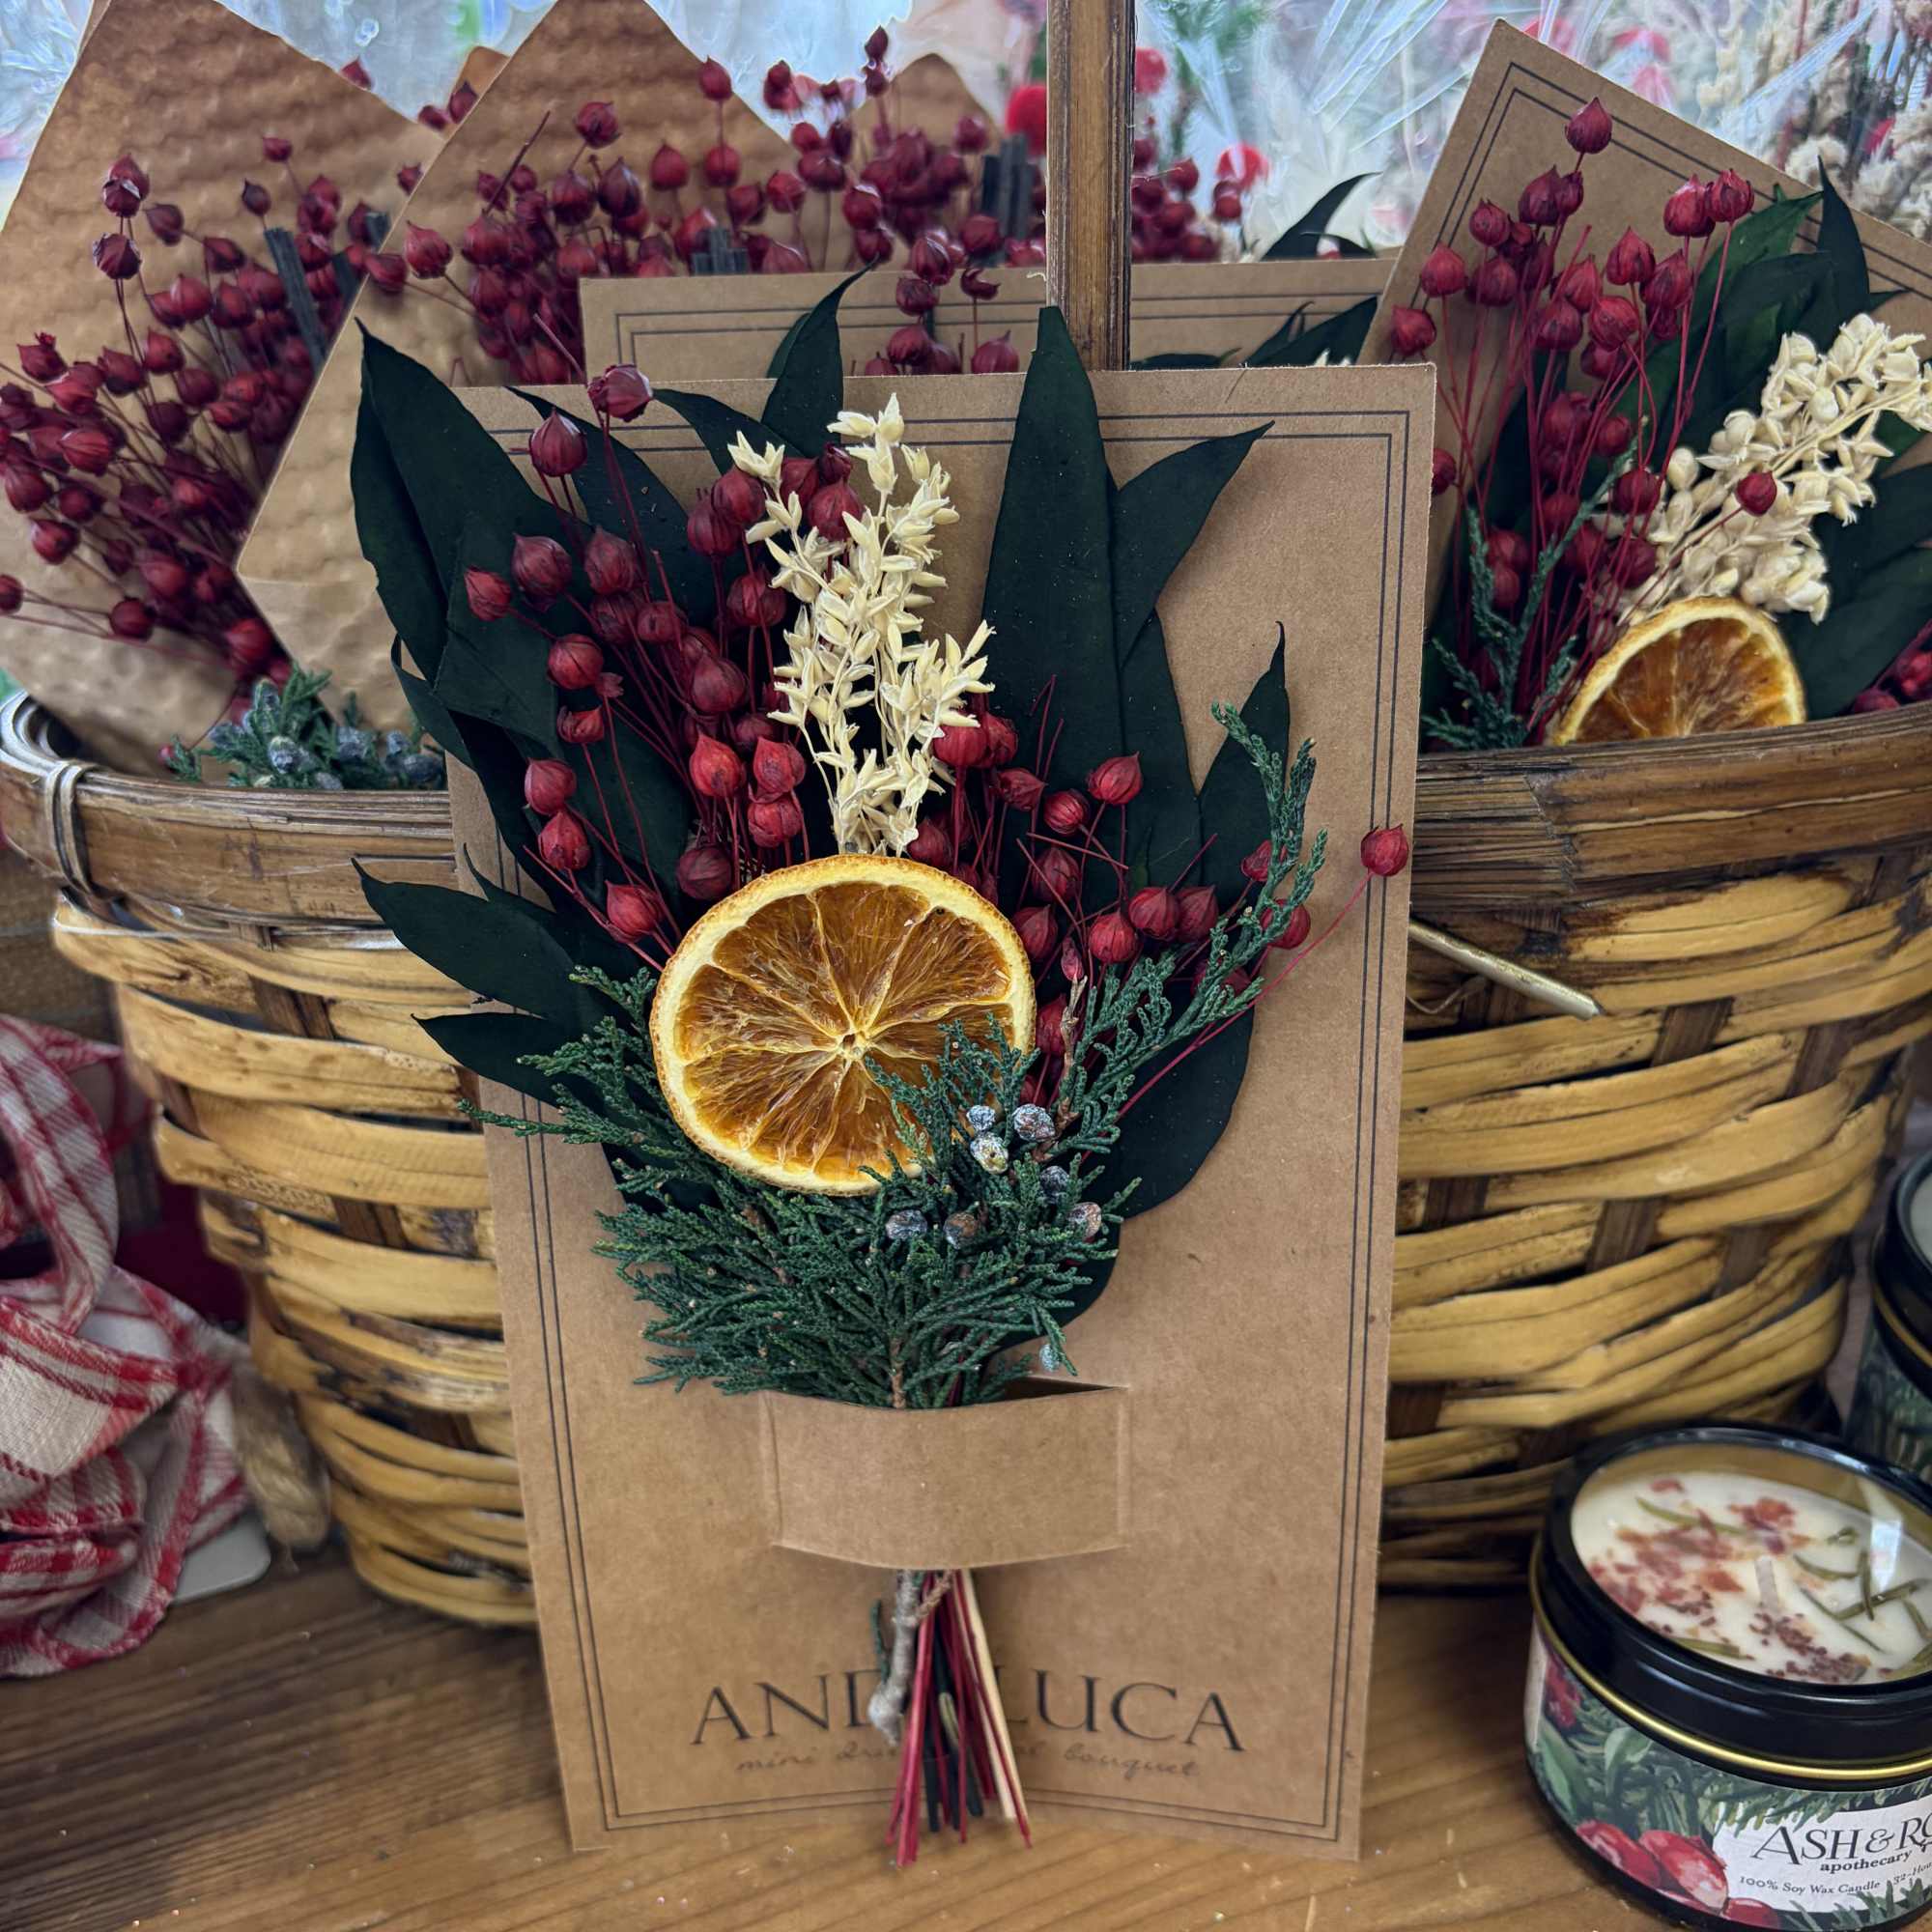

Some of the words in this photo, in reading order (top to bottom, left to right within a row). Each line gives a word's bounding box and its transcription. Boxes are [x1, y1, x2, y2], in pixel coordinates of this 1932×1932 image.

[1064, 1743, 1200, 1780] bouquet
[1820, 1850, 1913, 1874] apothecary
[1739, 1876, 1779, 1890] 100%
[1782, 1882, 1805, 1896] Soy
[1810, 1885, 1835, 1895] Wax
[1838, 1880, 1881, 1893] Candle
